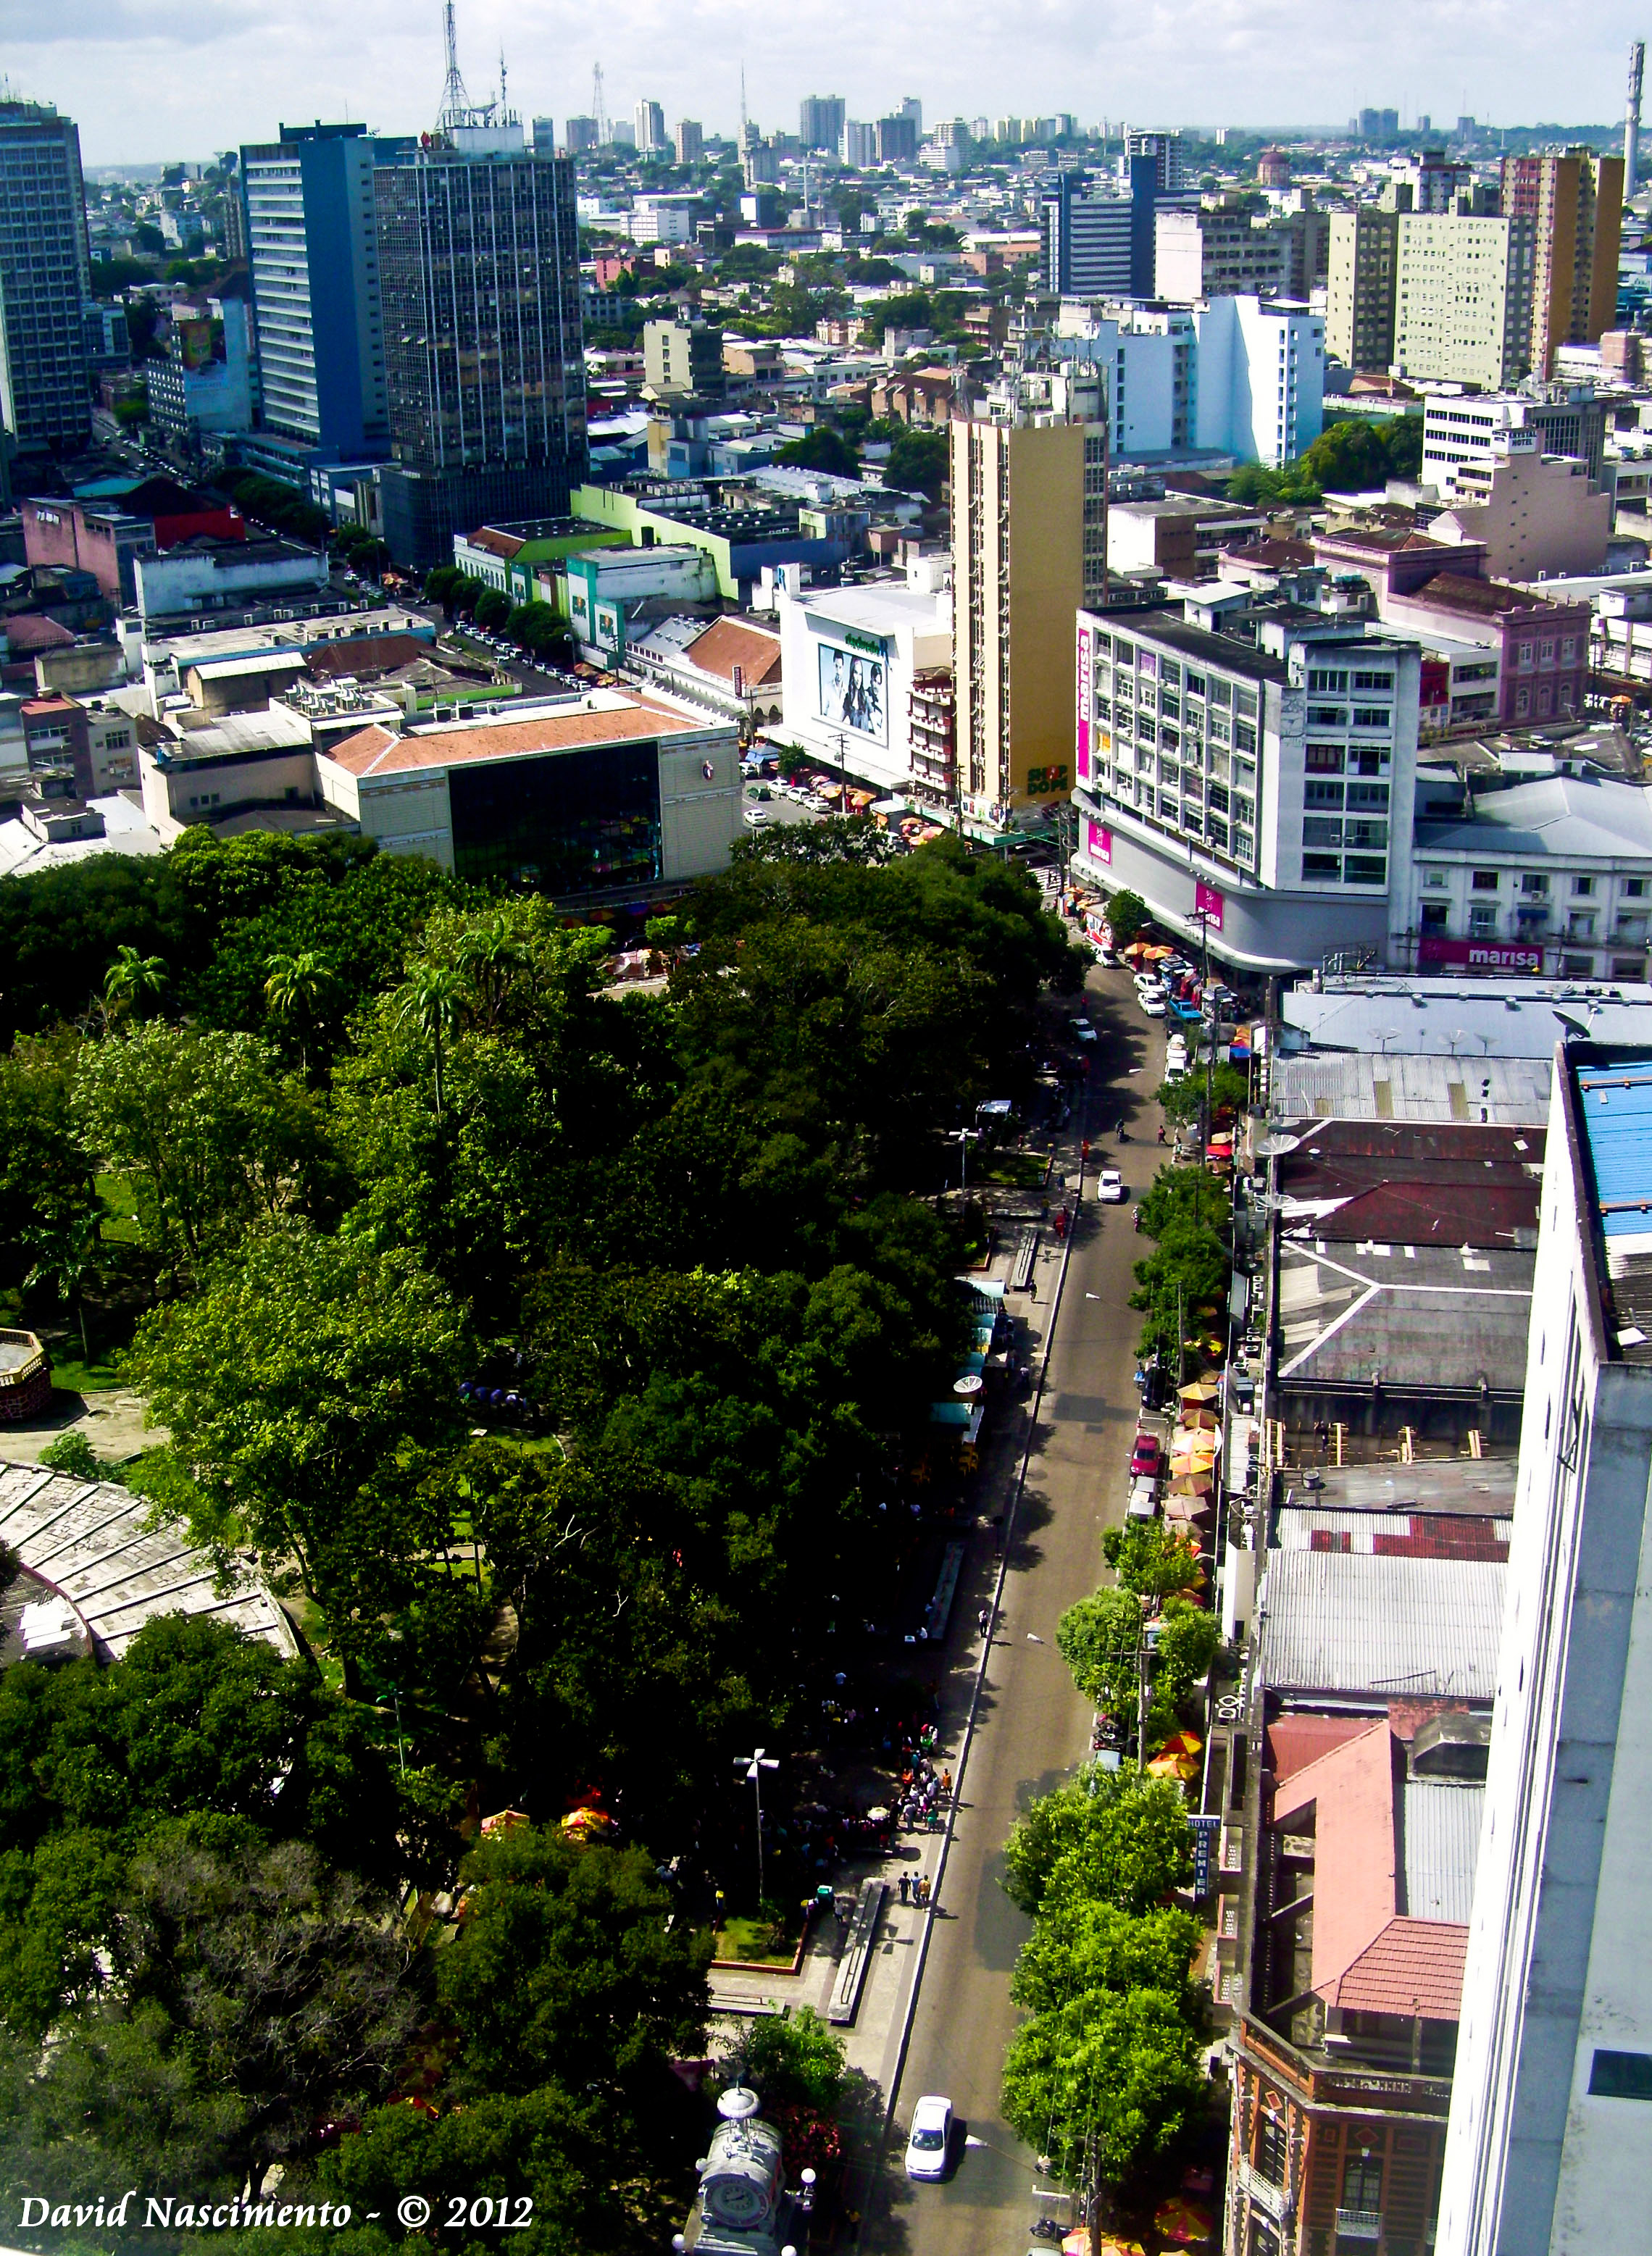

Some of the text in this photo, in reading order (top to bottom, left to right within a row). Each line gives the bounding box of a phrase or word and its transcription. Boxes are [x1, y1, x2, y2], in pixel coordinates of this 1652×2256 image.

[1080, 635, 1090, 722] marisa
[1469, 949, 1539, 967] marisa
[1196, 1830, 1208, 1895] PREMIER
